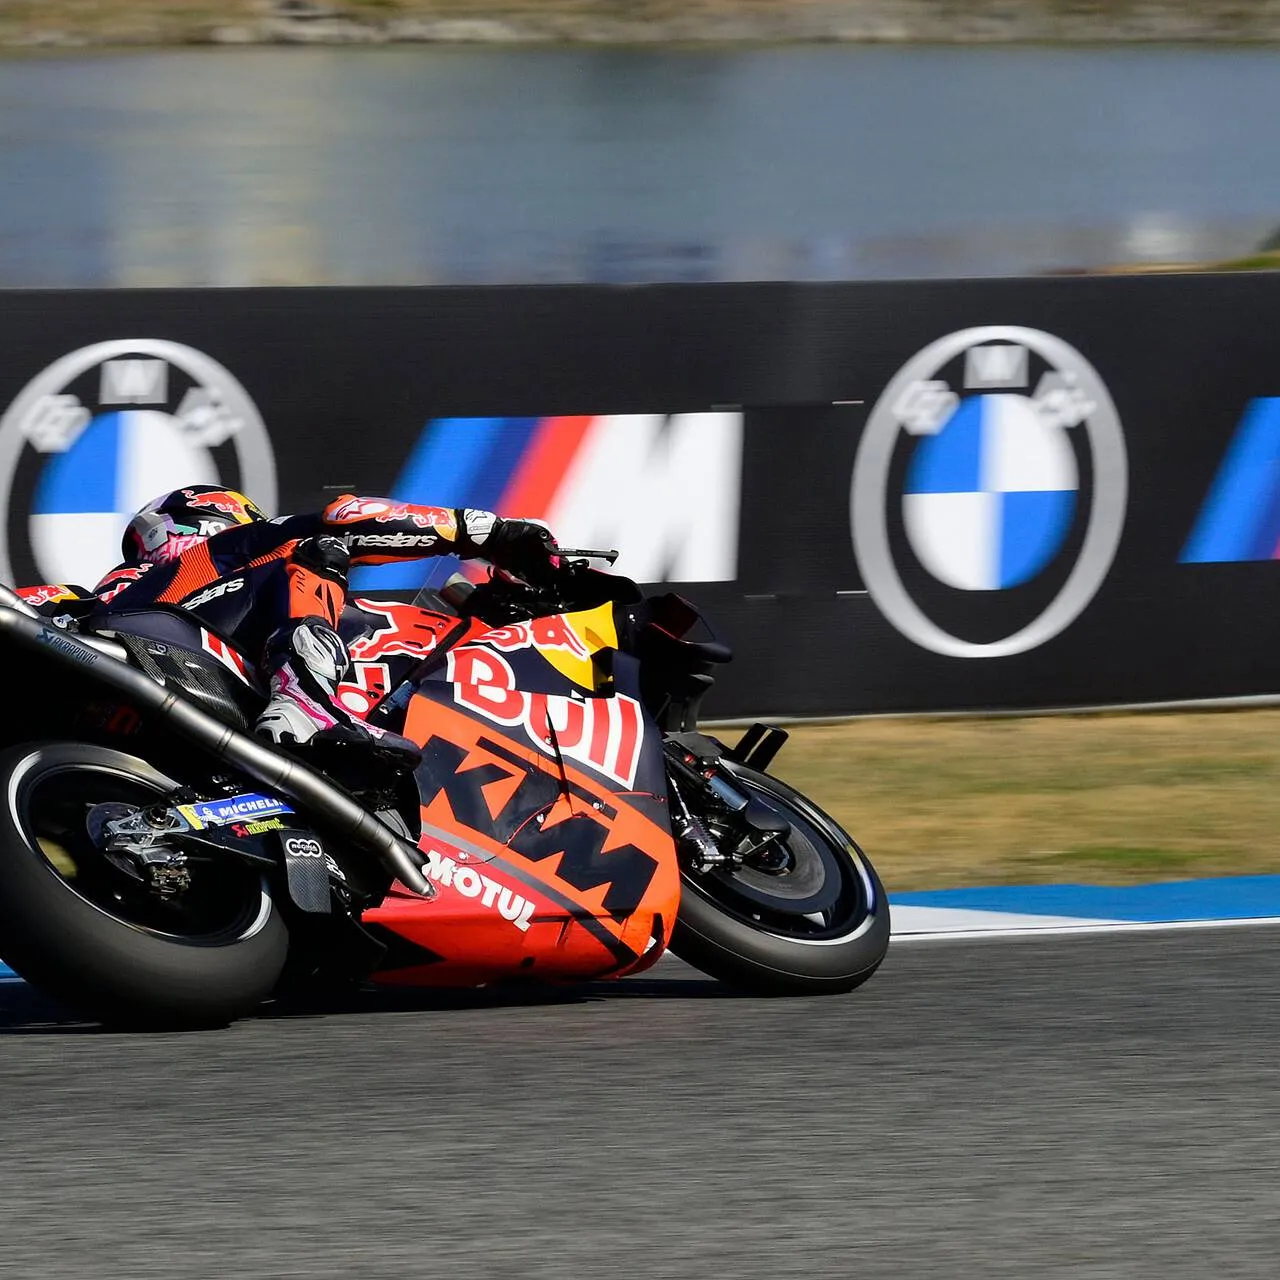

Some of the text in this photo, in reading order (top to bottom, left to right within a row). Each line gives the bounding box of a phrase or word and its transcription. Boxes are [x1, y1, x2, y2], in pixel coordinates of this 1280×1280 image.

[447, 643, 645, 792] Bull
[413, 734, 660, 926] KTM
[421, 849, 536, 933] MOTUL
